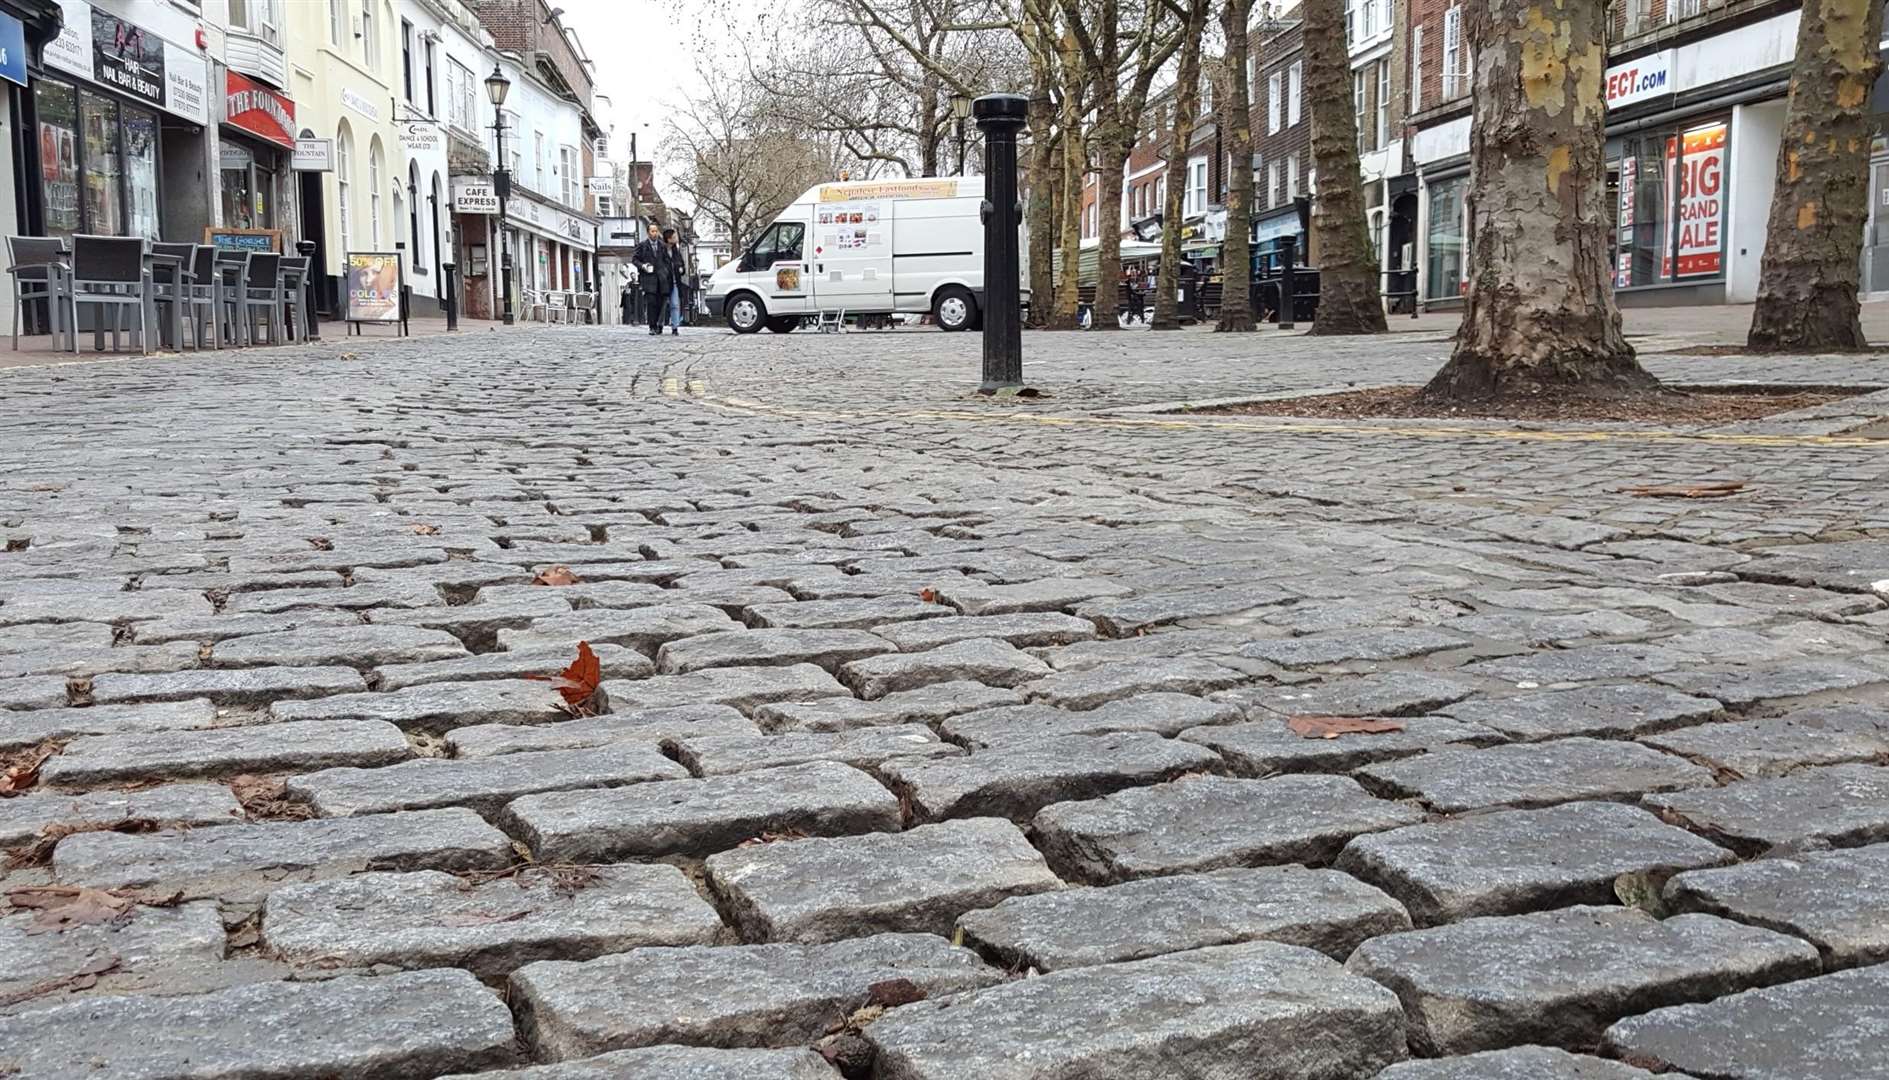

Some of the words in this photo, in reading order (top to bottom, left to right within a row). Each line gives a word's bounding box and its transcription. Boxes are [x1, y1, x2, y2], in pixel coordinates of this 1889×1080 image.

[124, 57, 140, 75] HAIR
[103, 64, 118, 83] NAIL
[118, 70, 132, 89] BAR
[132, 77, 137, 91] &
[137, 79, 160, 100] BEAUTY
[1606, 68, 1667, 100] ECT.COM
[226, 91, 250, 117] THE
[465, 188, 488, 197] CAFE
[590, 182, 612, 191] Nails
[457, 197, 496, 206] EXPRESS
[1678, 199, 1719, 221] RAND
[1678, 221, 1719, 249] ALE
[374, 257, 397, 267] OFF
[350, 289, 398, 299] COLOS
